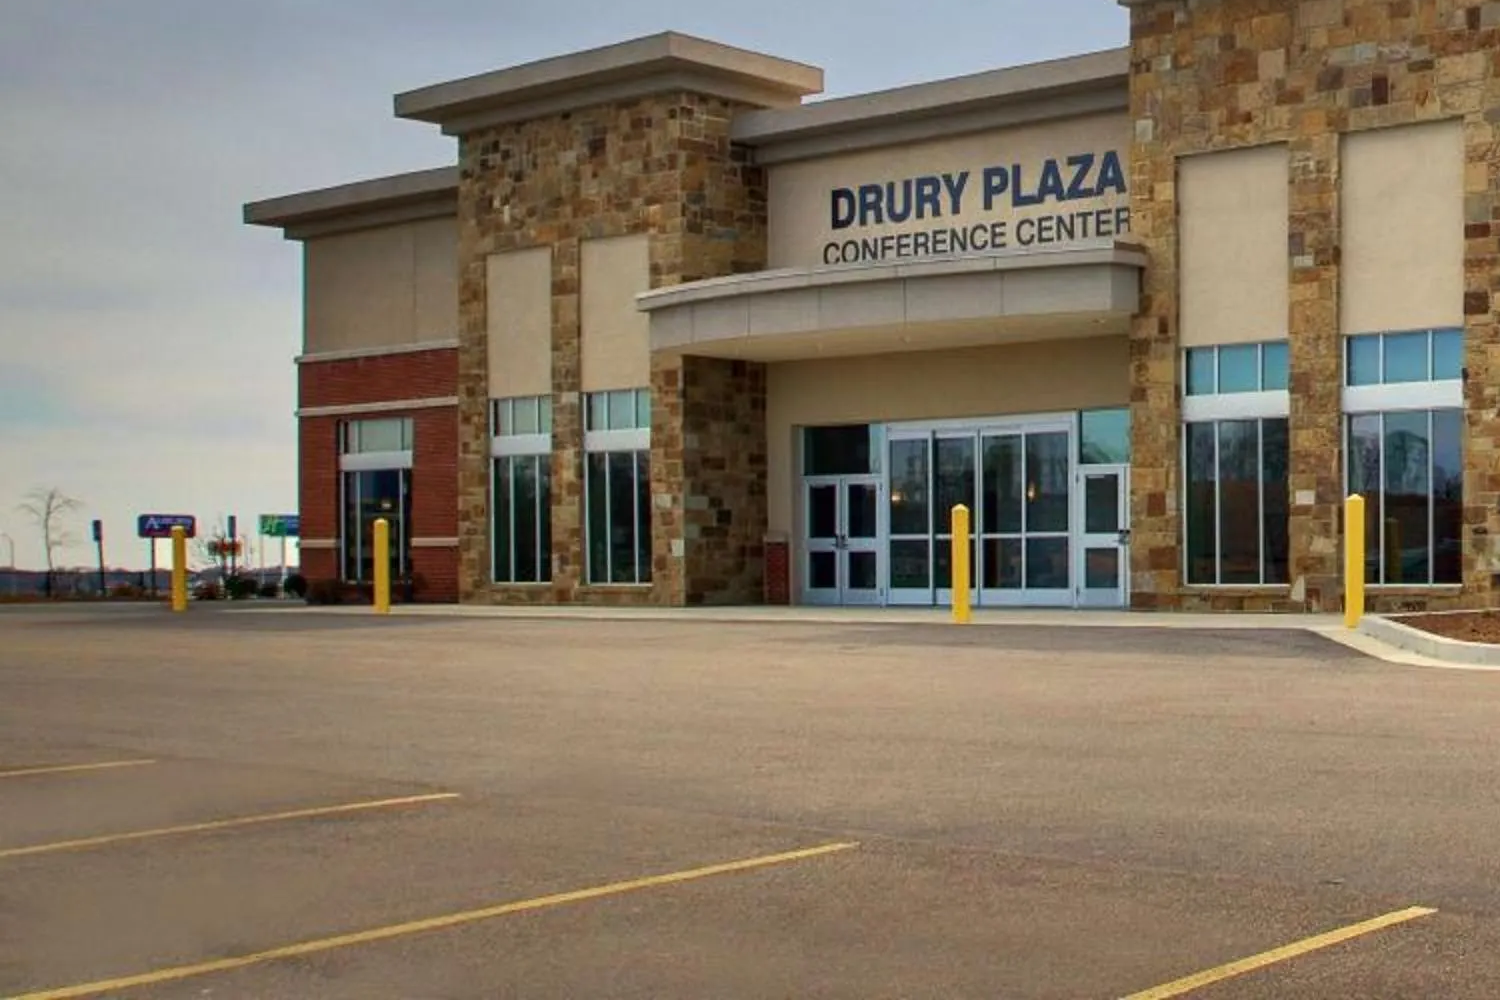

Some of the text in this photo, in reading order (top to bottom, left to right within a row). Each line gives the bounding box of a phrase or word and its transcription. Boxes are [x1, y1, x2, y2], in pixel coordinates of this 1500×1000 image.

[831, 151, 1127, 230] DRURY PLAZA
[823, 207, 1131, 265] CONFERENCE CENTER
